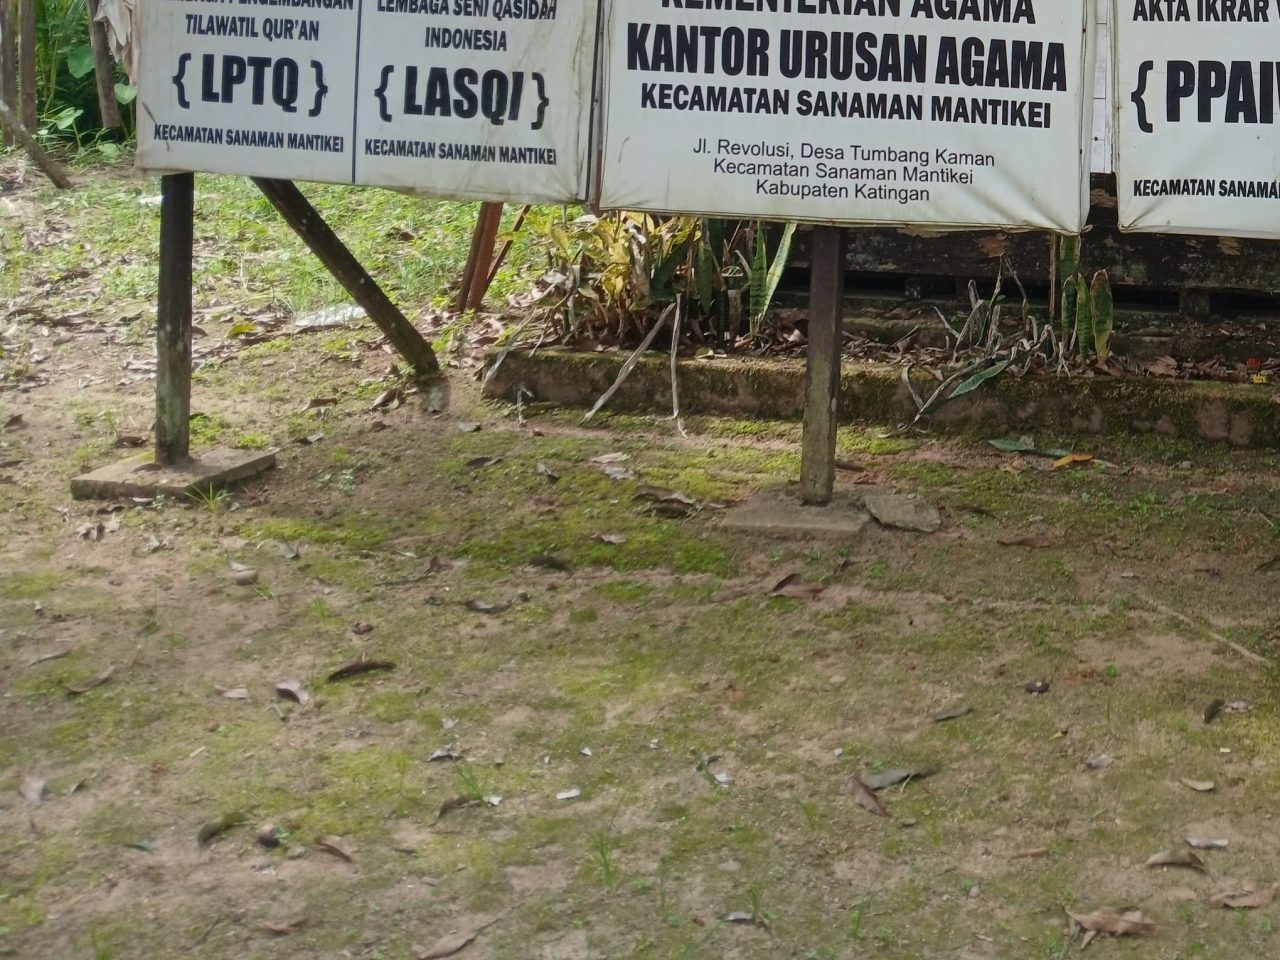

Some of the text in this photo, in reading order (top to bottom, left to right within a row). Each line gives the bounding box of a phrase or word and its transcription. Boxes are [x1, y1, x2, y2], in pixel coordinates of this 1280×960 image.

[186, 14, 258, 37] TILAWATIL
[425, 27, 506, 51] INDONESIA
[628, 23, 1066, 91] KANTOR URUSAN AGAMA
[642, 83, 1050, 128] KECAMATAN SANAMAN MANTIKEI
[154, 123, 343, 152] KECAMATAN SANAMAN MANTIKEI
[365, 139, 556, 165] KECAMATAN SANAMAN MANTIKEI
[718, 139, 793, 159] Revolusi,
[801, 143, 844, 159] Desa
[850, 145, 928, 166] Tumbang
[936, 149, 994, 166] Kaman
[714, 158, 972, 184] Kecamatan Sanaman Mantikei
[757, 179, 929, 204] Kabupaten Katingan
[1134, 179, 1214, 196] KECAMATAN
